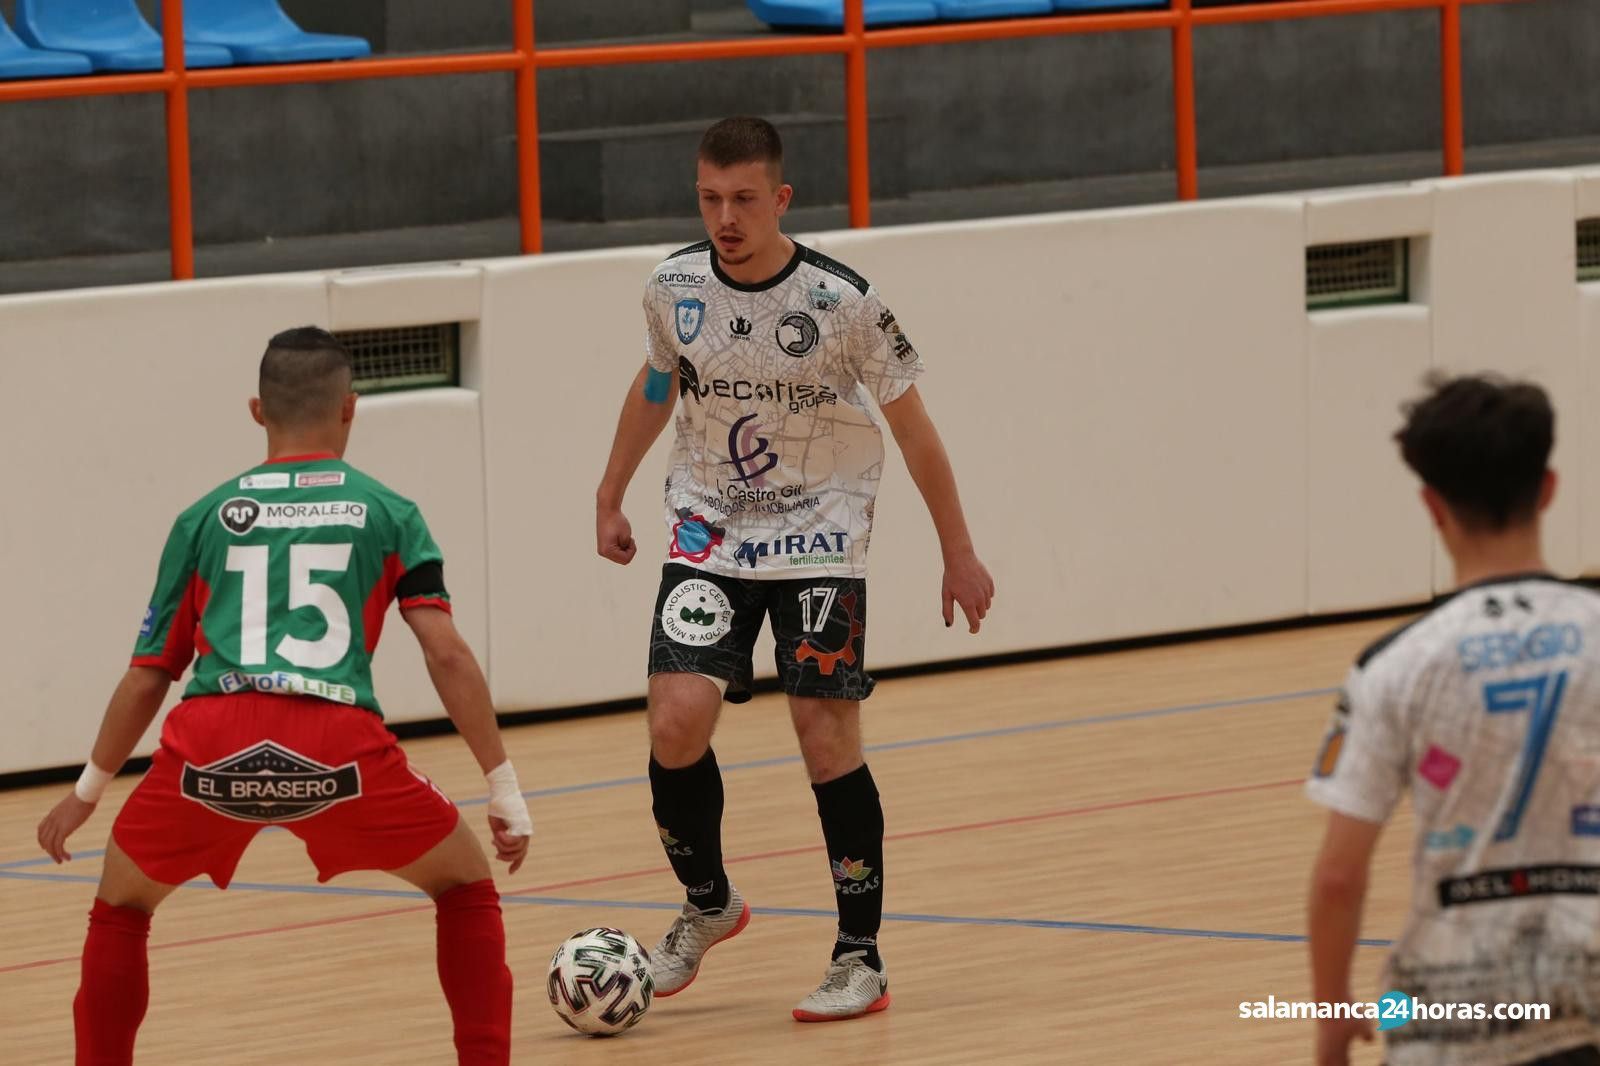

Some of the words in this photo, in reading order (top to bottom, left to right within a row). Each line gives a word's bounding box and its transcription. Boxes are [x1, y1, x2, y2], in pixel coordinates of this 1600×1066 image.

[657, 272, 707, 284] euronics
[825, 264, 860, 286] SALAMANCA
[789, 396, 836, 414] grupo
[726, 484, 776, 503] Castro
[780, 484, 802, 498] Gil
[266, 504, 364, 518] MORALEJO
[789, 554, 845, 566] fertilizantes
[224, 542, 353, 669] 15
[666, 583, 707, 611] HOLISTIC
[709, 588, 731, 623] CENER
[798, 587, 838, 633] 17
[666, 617, 687, 639] MIND
[303, 680, 354, 703] LIFE
[1483, 670, 1568, 842] 7
[197, 777, 223, 797] EL
[230, 778, 338, 798] BRASERO
